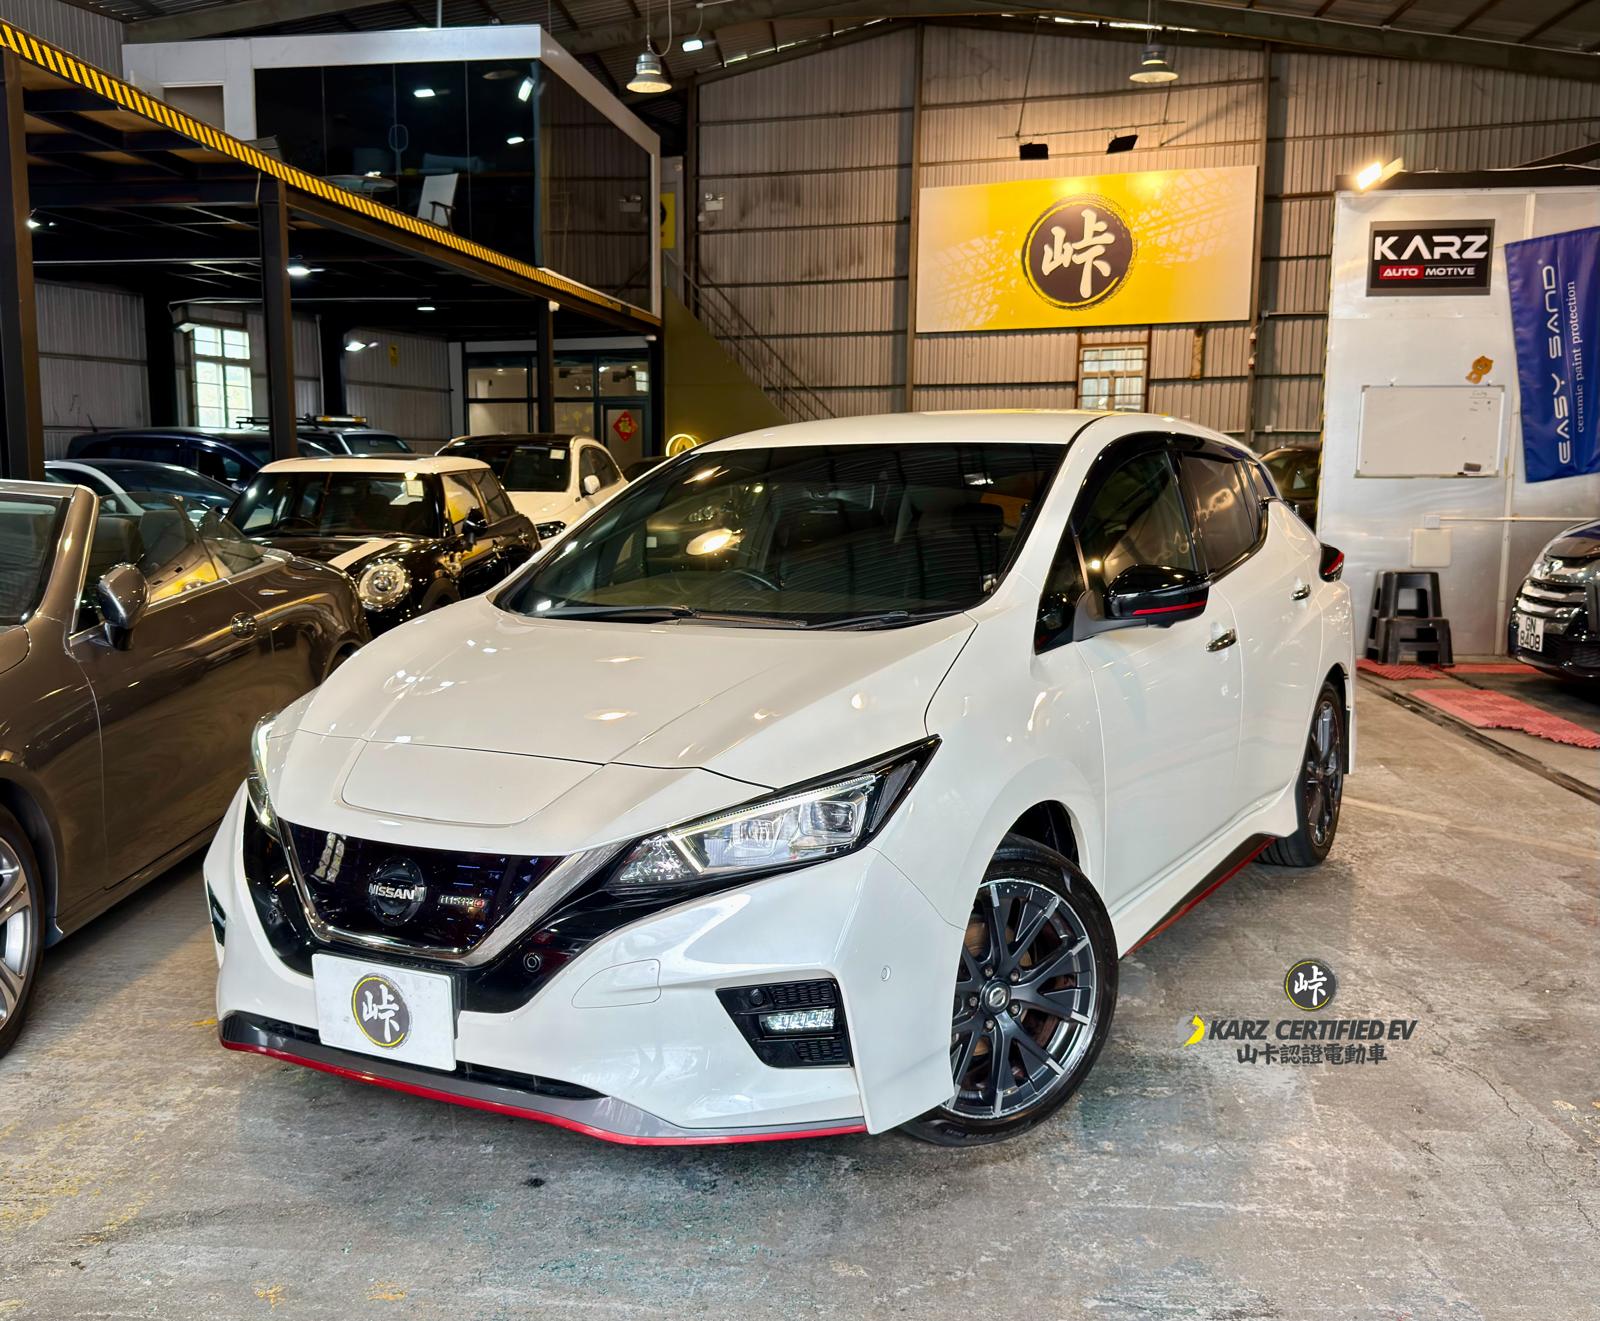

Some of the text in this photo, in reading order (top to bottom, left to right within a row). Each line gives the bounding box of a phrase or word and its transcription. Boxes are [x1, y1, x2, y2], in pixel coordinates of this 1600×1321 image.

[1042, 209, 1115, 299] 峠
[1373, 235, 1489, 261] KARZ
[1383, 266, 1475, 277] AUTO MOTIVE
[1542, 265, 1572, 464] EASY SAND
[1566, 280, 1585, 433] ceramic paint protection
[1525, 616, 1537, 633] GN
[1519, 630, 1541, 649] 8408
[368, 883, 415, 900] NISSAN
[362, 984, 400, 1042] 峠
